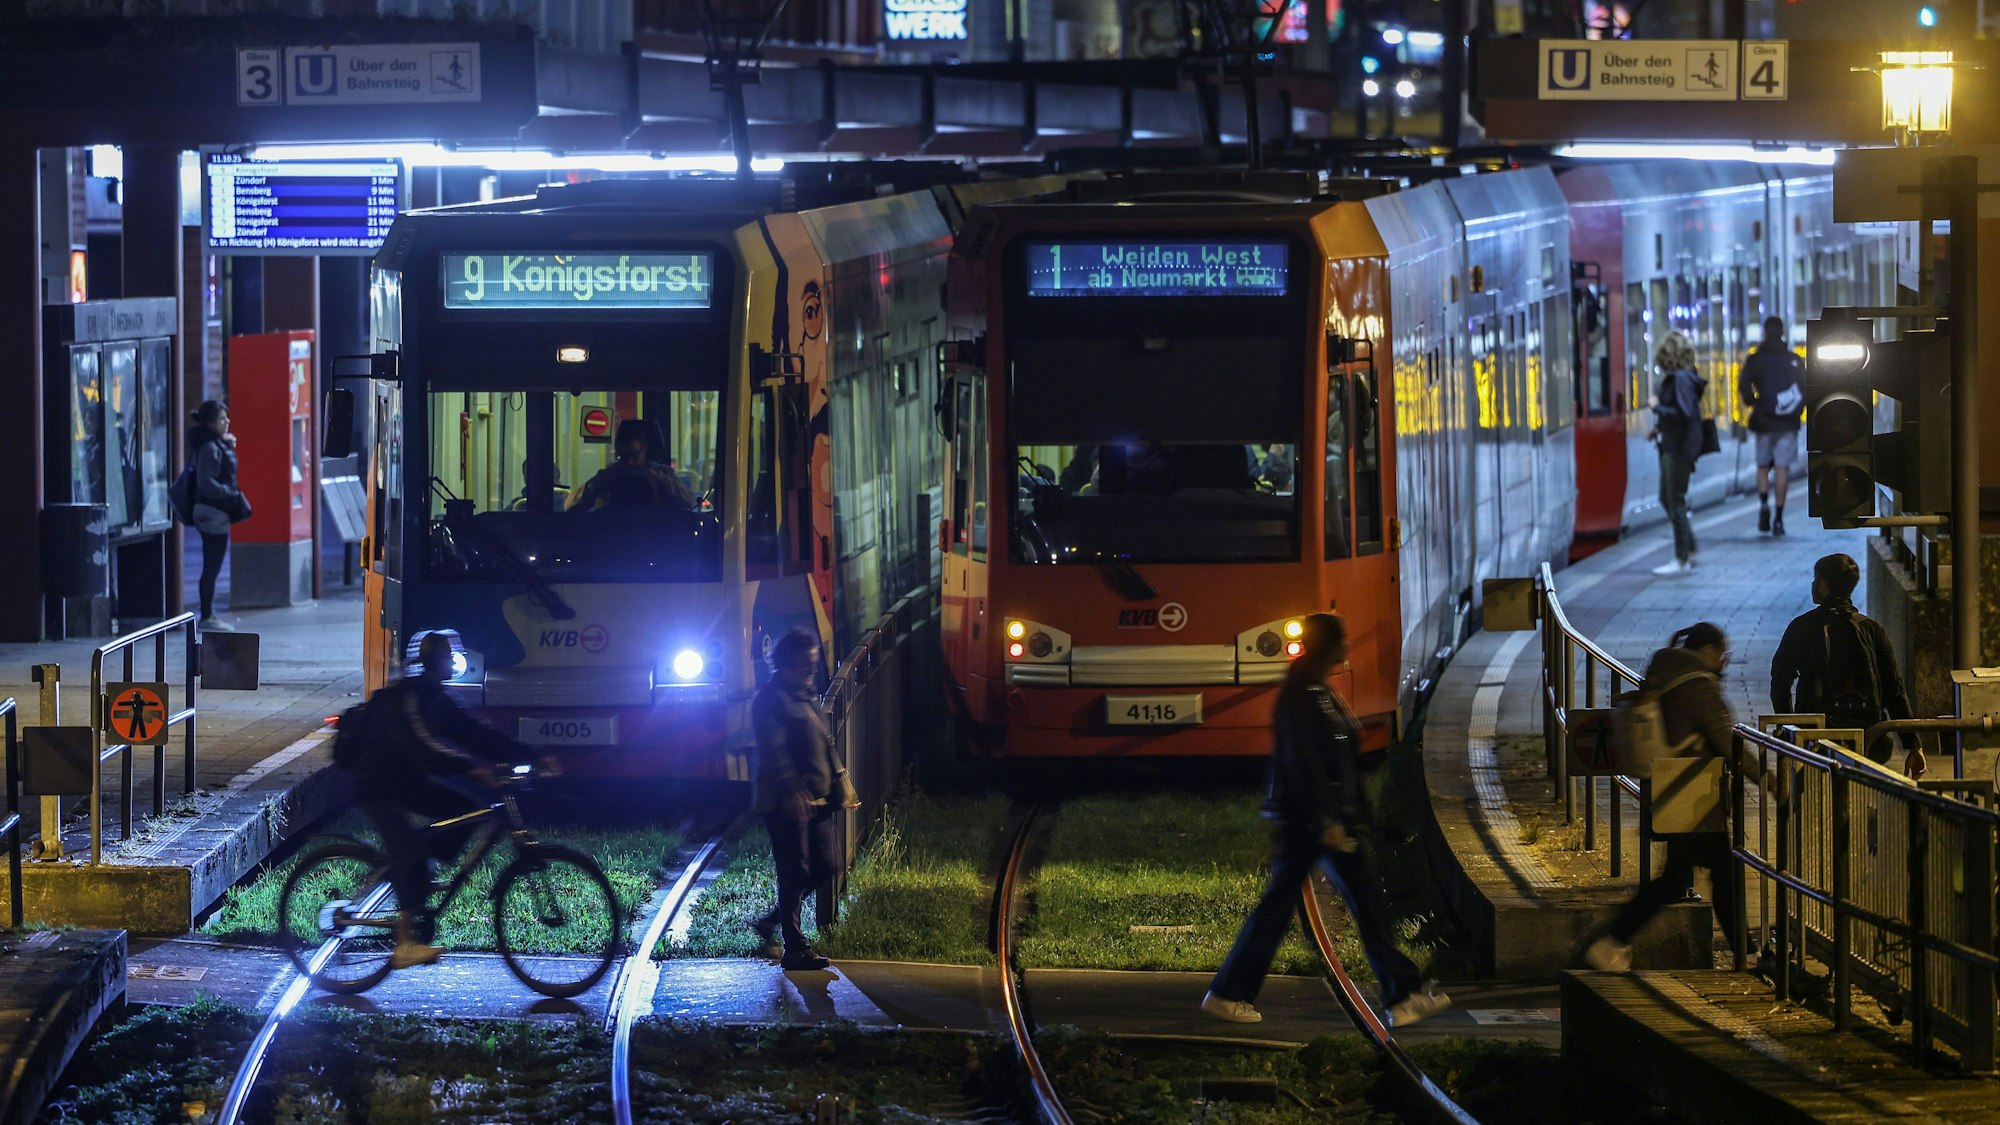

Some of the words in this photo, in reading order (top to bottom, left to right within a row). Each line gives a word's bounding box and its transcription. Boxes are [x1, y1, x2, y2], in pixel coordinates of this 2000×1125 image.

[885, 11, 968, 40] WERK
[246, 52, 271, 61] Gleis
[1753, 46, 1777, 55] Gleis
[350, 56, 384, 72] Über
[390, 59, 416, 71] den
[1604, 51, 1639, 68] Über
[1645, 55, 1671, 67] den
[298, 56, 334, 94] U
[1551, 51, 1587, 88] U
[1750, 60, 1779, 94] 4
[246, 65, 272, 100] 3
[347, 77, 421, 91] Bahnsteig
[1600, 73, 1675, 88] Bahnsteig
[235, 176, 266, 185] Zündorf
[371, 177, 378, 185] 3
[378, 177, 394, 185] Min
[235, 186, 272, 196] Bensberg
[371, 186, 378, 195] 9
[378, 186, 394, 195] Min
[236, 197, 278, 206] Königsforst
[367, 197, 377, 205] 11
[378, 197, 394, 205] Min
[236, 207, 272, 217] Bensberg
[367, 207, 378, 216] 19
[378, 207, 394, 216] Min
[236, 218, 279, 227] Königsforst
[367, 218, 378, 226] 21
[237, 227, 268, 236] Zündorf
[367, 227, 378, 236] 23
[229, 238, 263, 248] Richtung
[277, 238, 319, 248] Königsforst
[320, 238, 338, 247] wird
[339, 238, 358, 247] nicht
[1050, 245, 1061, 290] 1
[1102, 246, 1188, 265] Weiden
[1201, 246, 1261, 265] West
[464, 255, 485, 301] 9
[503, 255, 702, 301] Königsforst
[1088, 268, 1113, 287] ab
[1122, 268, 1227, 288] Neumarkt
[1118, 608, 1157, 625] KVB
[539, 631, 579, 648] KVB
[1127, 704, 1176, 720] 4118
[538, 722, 592, 738] 4005
